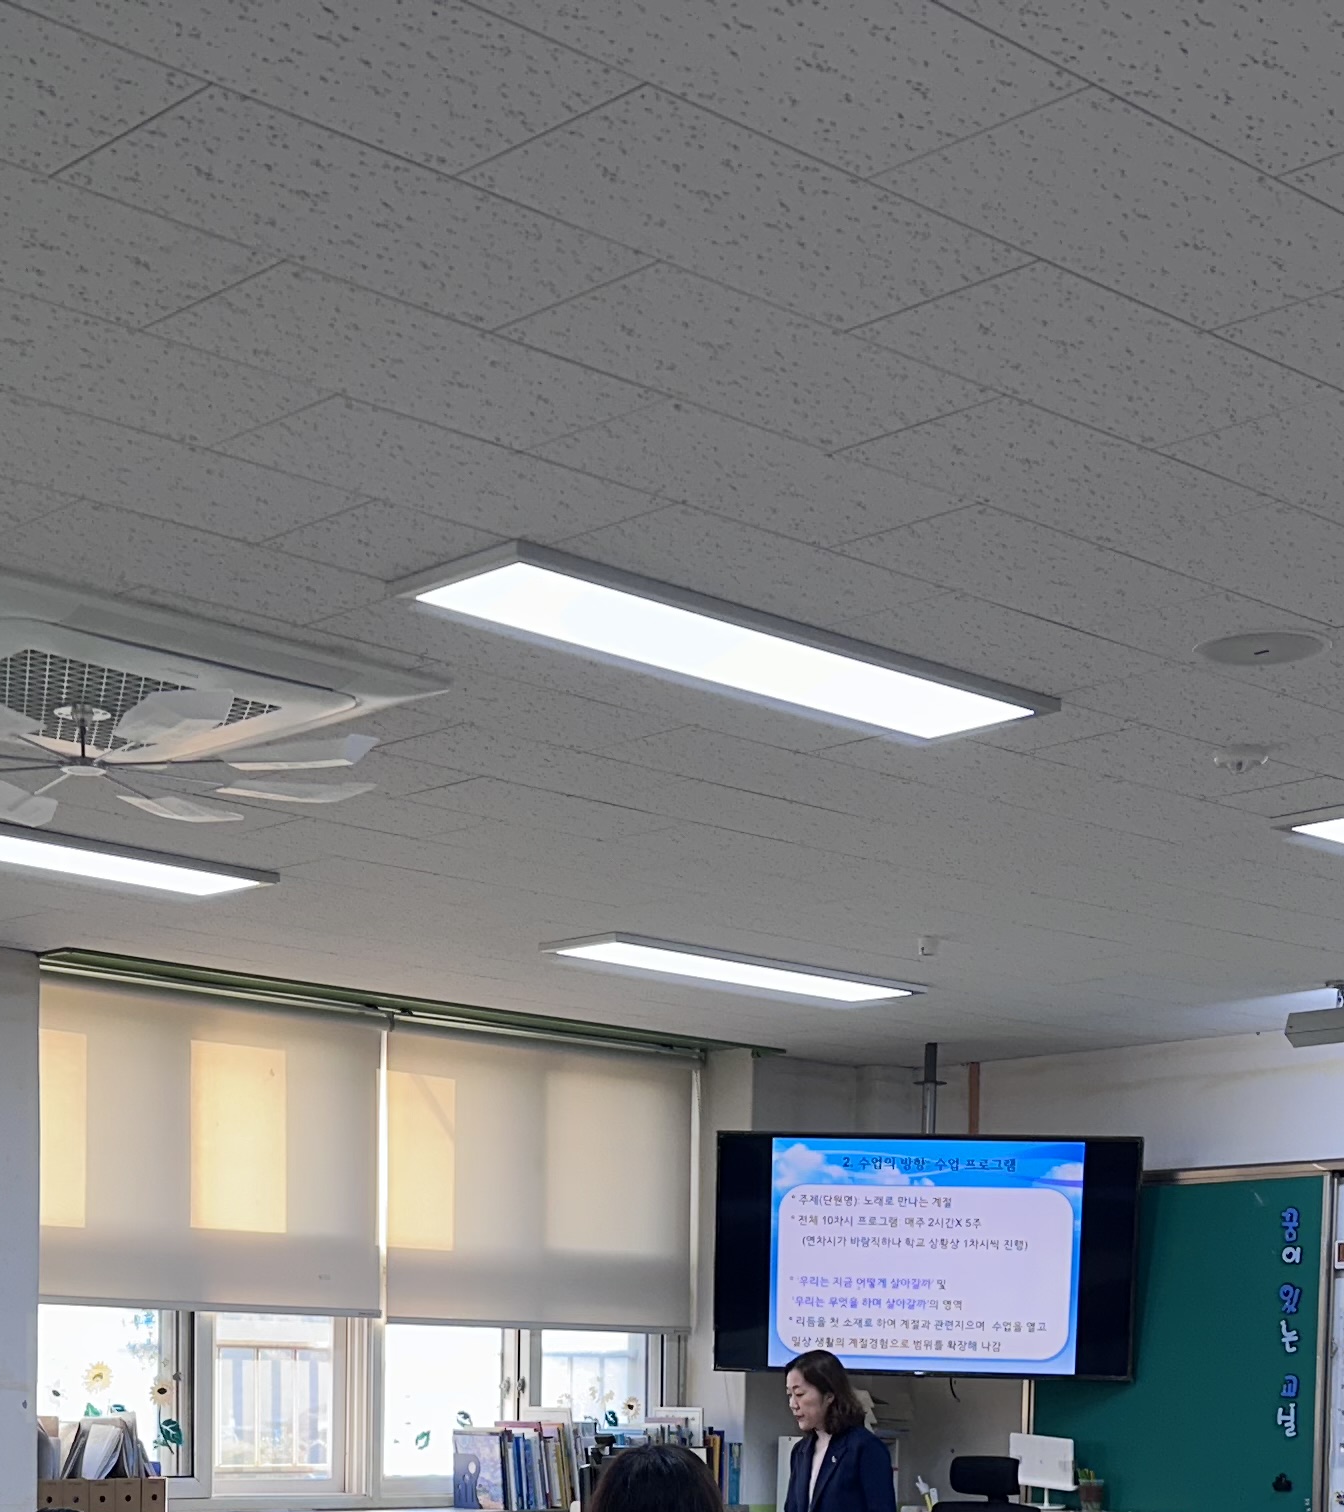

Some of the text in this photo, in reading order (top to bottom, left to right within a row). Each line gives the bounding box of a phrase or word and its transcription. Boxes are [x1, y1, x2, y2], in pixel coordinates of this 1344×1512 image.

[858, 1156, 896, 1170] 수업의
[935, 1158, 960, 1172] 수업
[964, 1158, 1017, 1173] 프로그램
[864, 1196, 895, 1207] 노래로
[897, 1196, 929, 1208] 만나는
[931, 1197, 952, 1209] 계절
[798, 1214, 818, 1227] 전체
[822, 1215, 854, 1227] 10차시
[904, 1237, 926, 1248] 학교
[832, 1276, 853, 1288] 지금
[856, 1277, 888, 1289] 어떻게
[828, 1296, 858, 1309] 무엇을
[842, 1317, 873, 1329] 소재로
[876, 1317, 897, 1329] 하여
[899, 1318, 931, 1330] 계절과
[933, 1319, 986, 1331] 관련지으며
[991, 1320, 1023, 1333] 수업을
[1278, 1284, 1301, 1353] 있는
